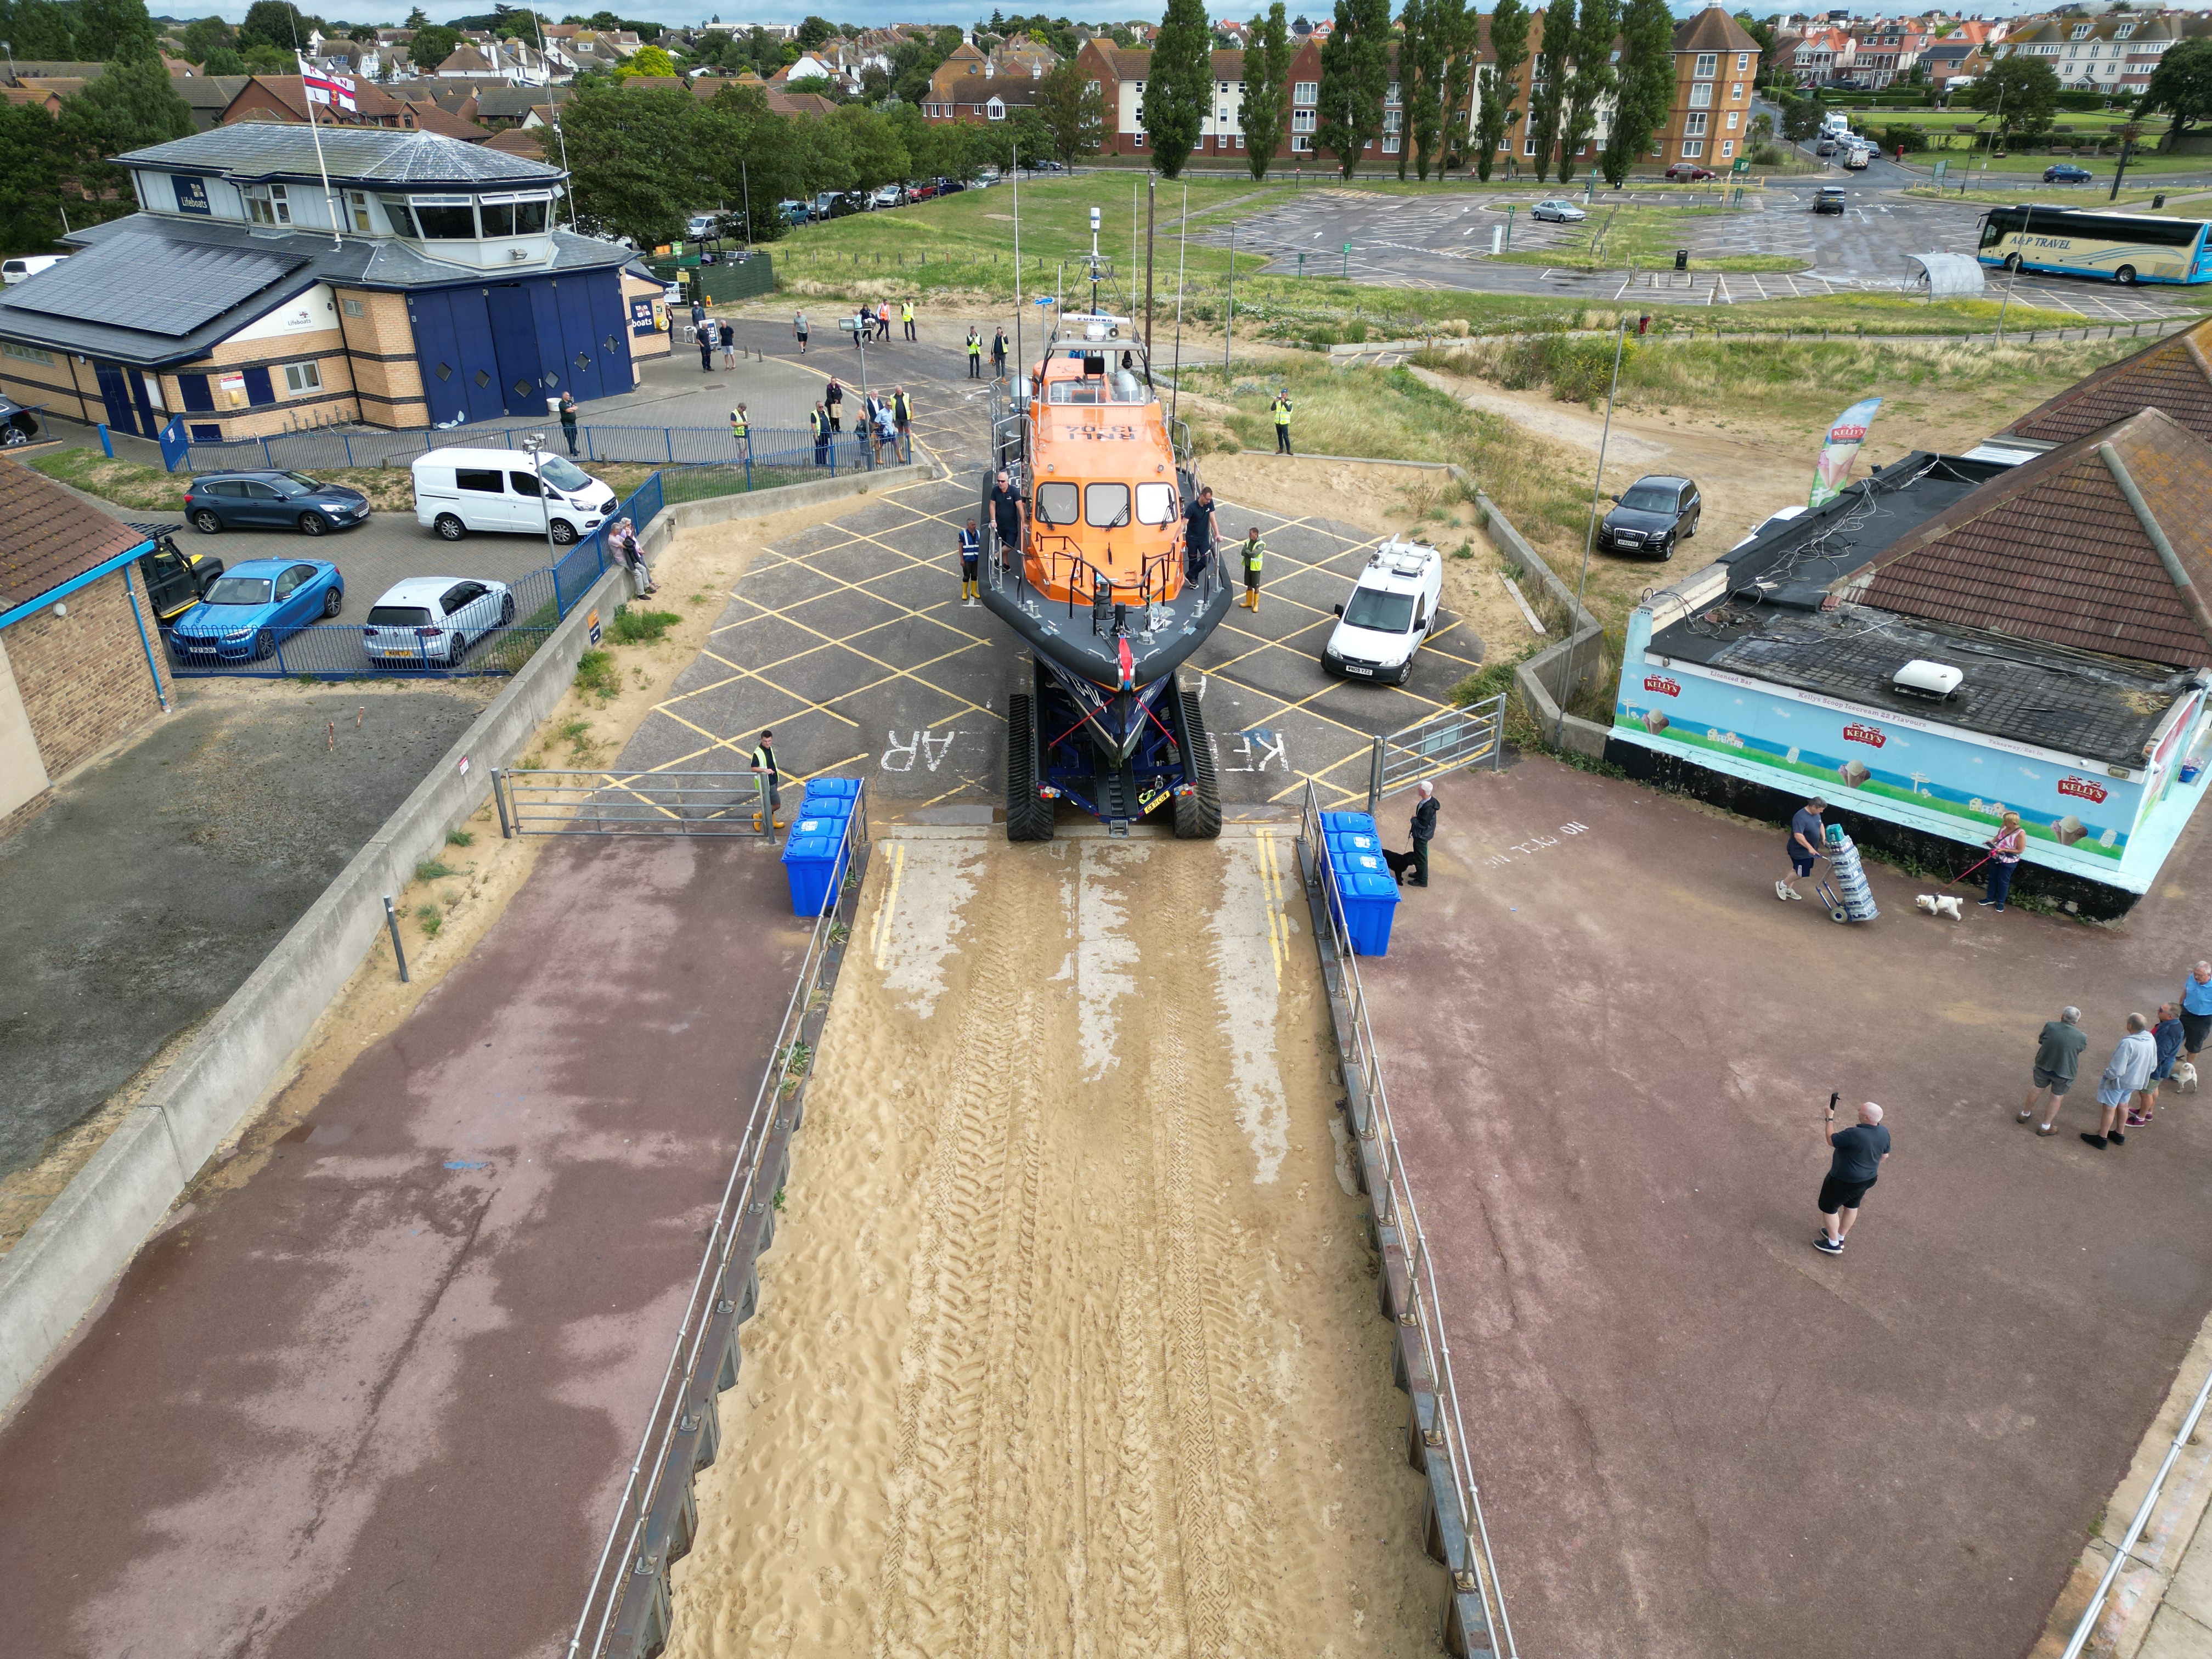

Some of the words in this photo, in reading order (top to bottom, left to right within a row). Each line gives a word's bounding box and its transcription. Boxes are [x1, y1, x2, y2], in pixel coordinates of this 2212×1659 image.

[340, 78, 347, 87] N
[313, 91, 320, 100] L
[180, 196, 208, 208] Lifeboats
[2034, 238, 2071, 250] TRAVEL
[1710, 670, 1739, 682] Licenced
[1647, 680, 1678, 693] KELLY'S
[1066, 673, 1107, 714] 13-04
[1798, 692, 1821, 703] Kellys
[1822, 698, 1843, 708] Scoop
[1845, 703, 1879, 716] Icecream
[1892, 715, 1927, 728] Flavours
[1847, 729, 1883, 743] KELLY'S
[1989, 739, 2035, 754] Takeaway/Eat
[2062, 782, 2103, 799] KELLY'S
[1559, 821, 1589, 835] NO
